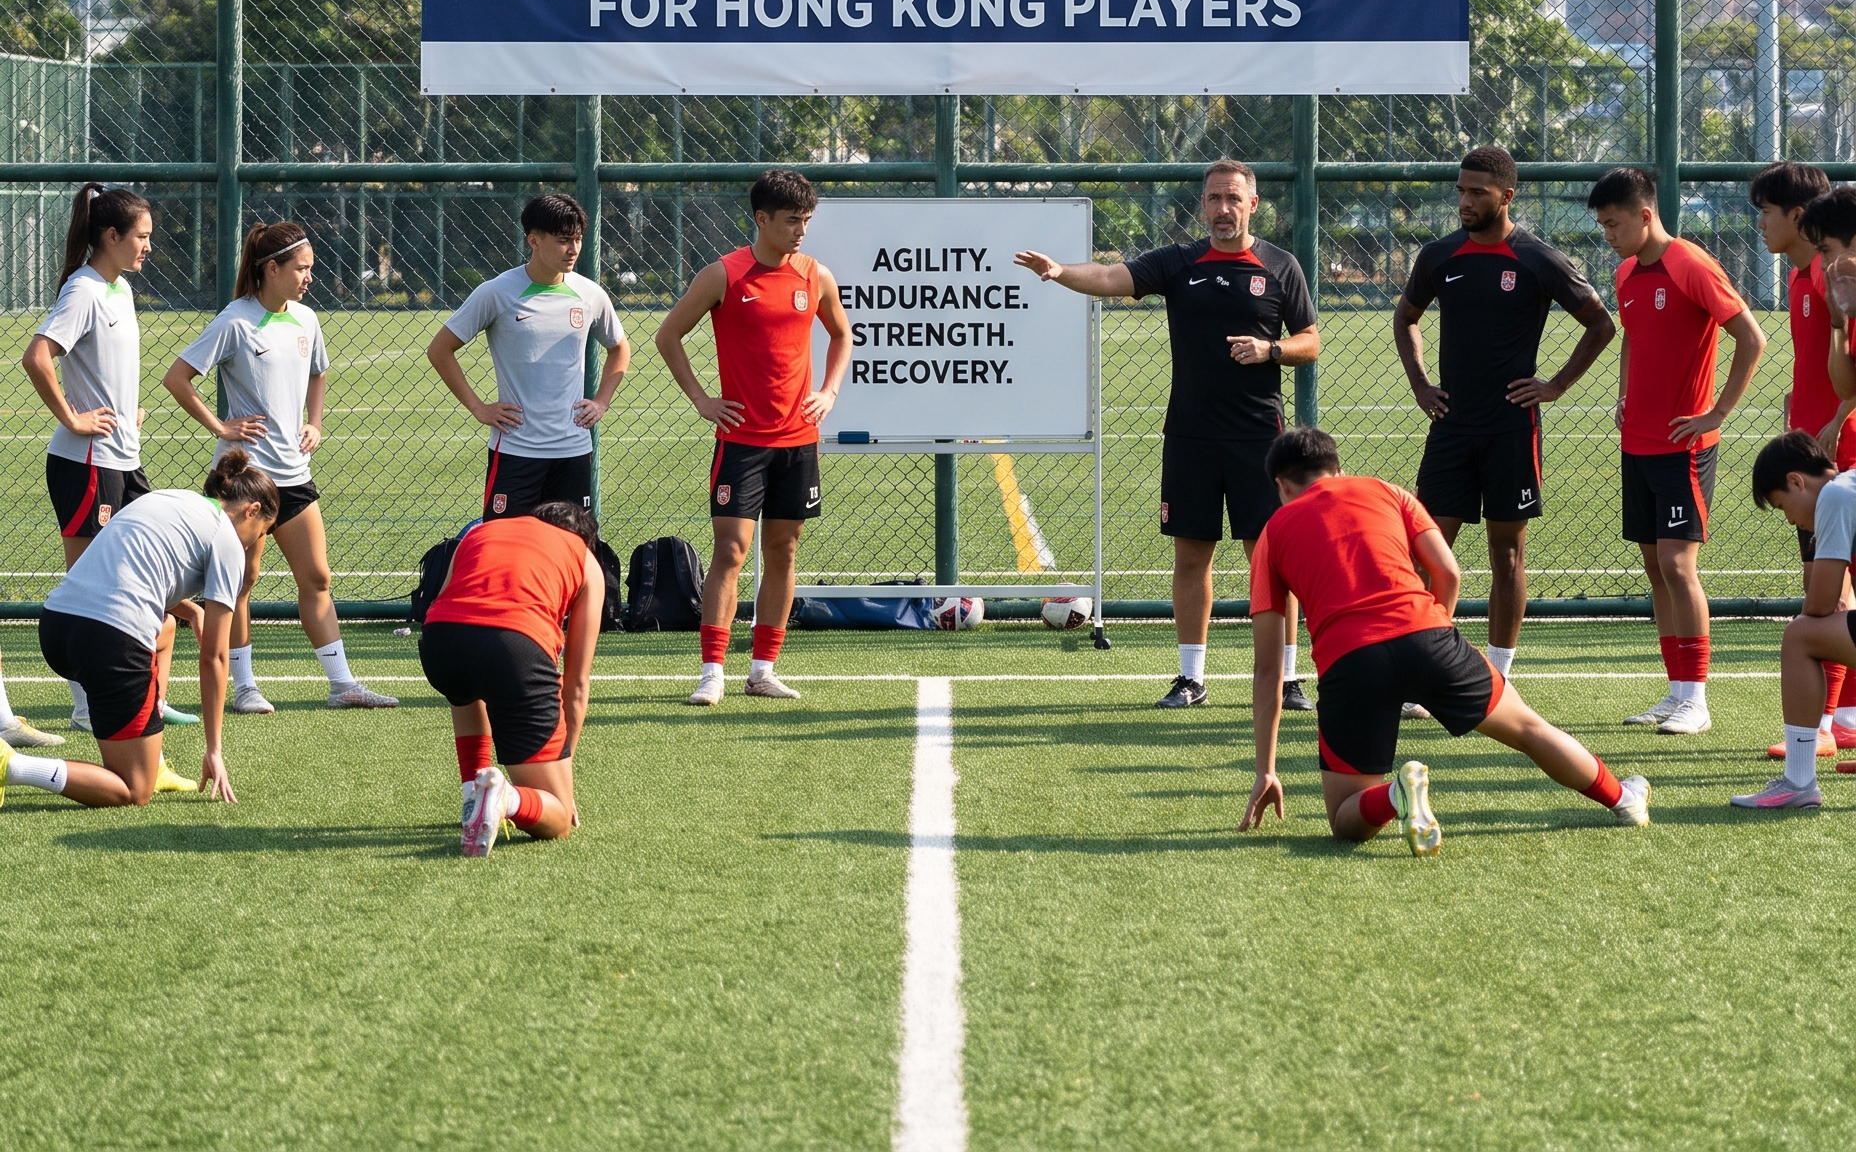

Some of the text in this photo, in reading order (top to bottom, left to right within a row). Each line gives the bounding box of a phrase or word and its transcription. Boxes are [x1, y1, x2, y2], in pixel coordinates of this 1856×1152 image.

[872, 248, 992, 272] AGILITY.
[838, 285, 1029, 310] ENDURANCE.
[851, 322, 1014, 347] STRENGTH.
[852, 359, 1013, 384] RECOVERY.
